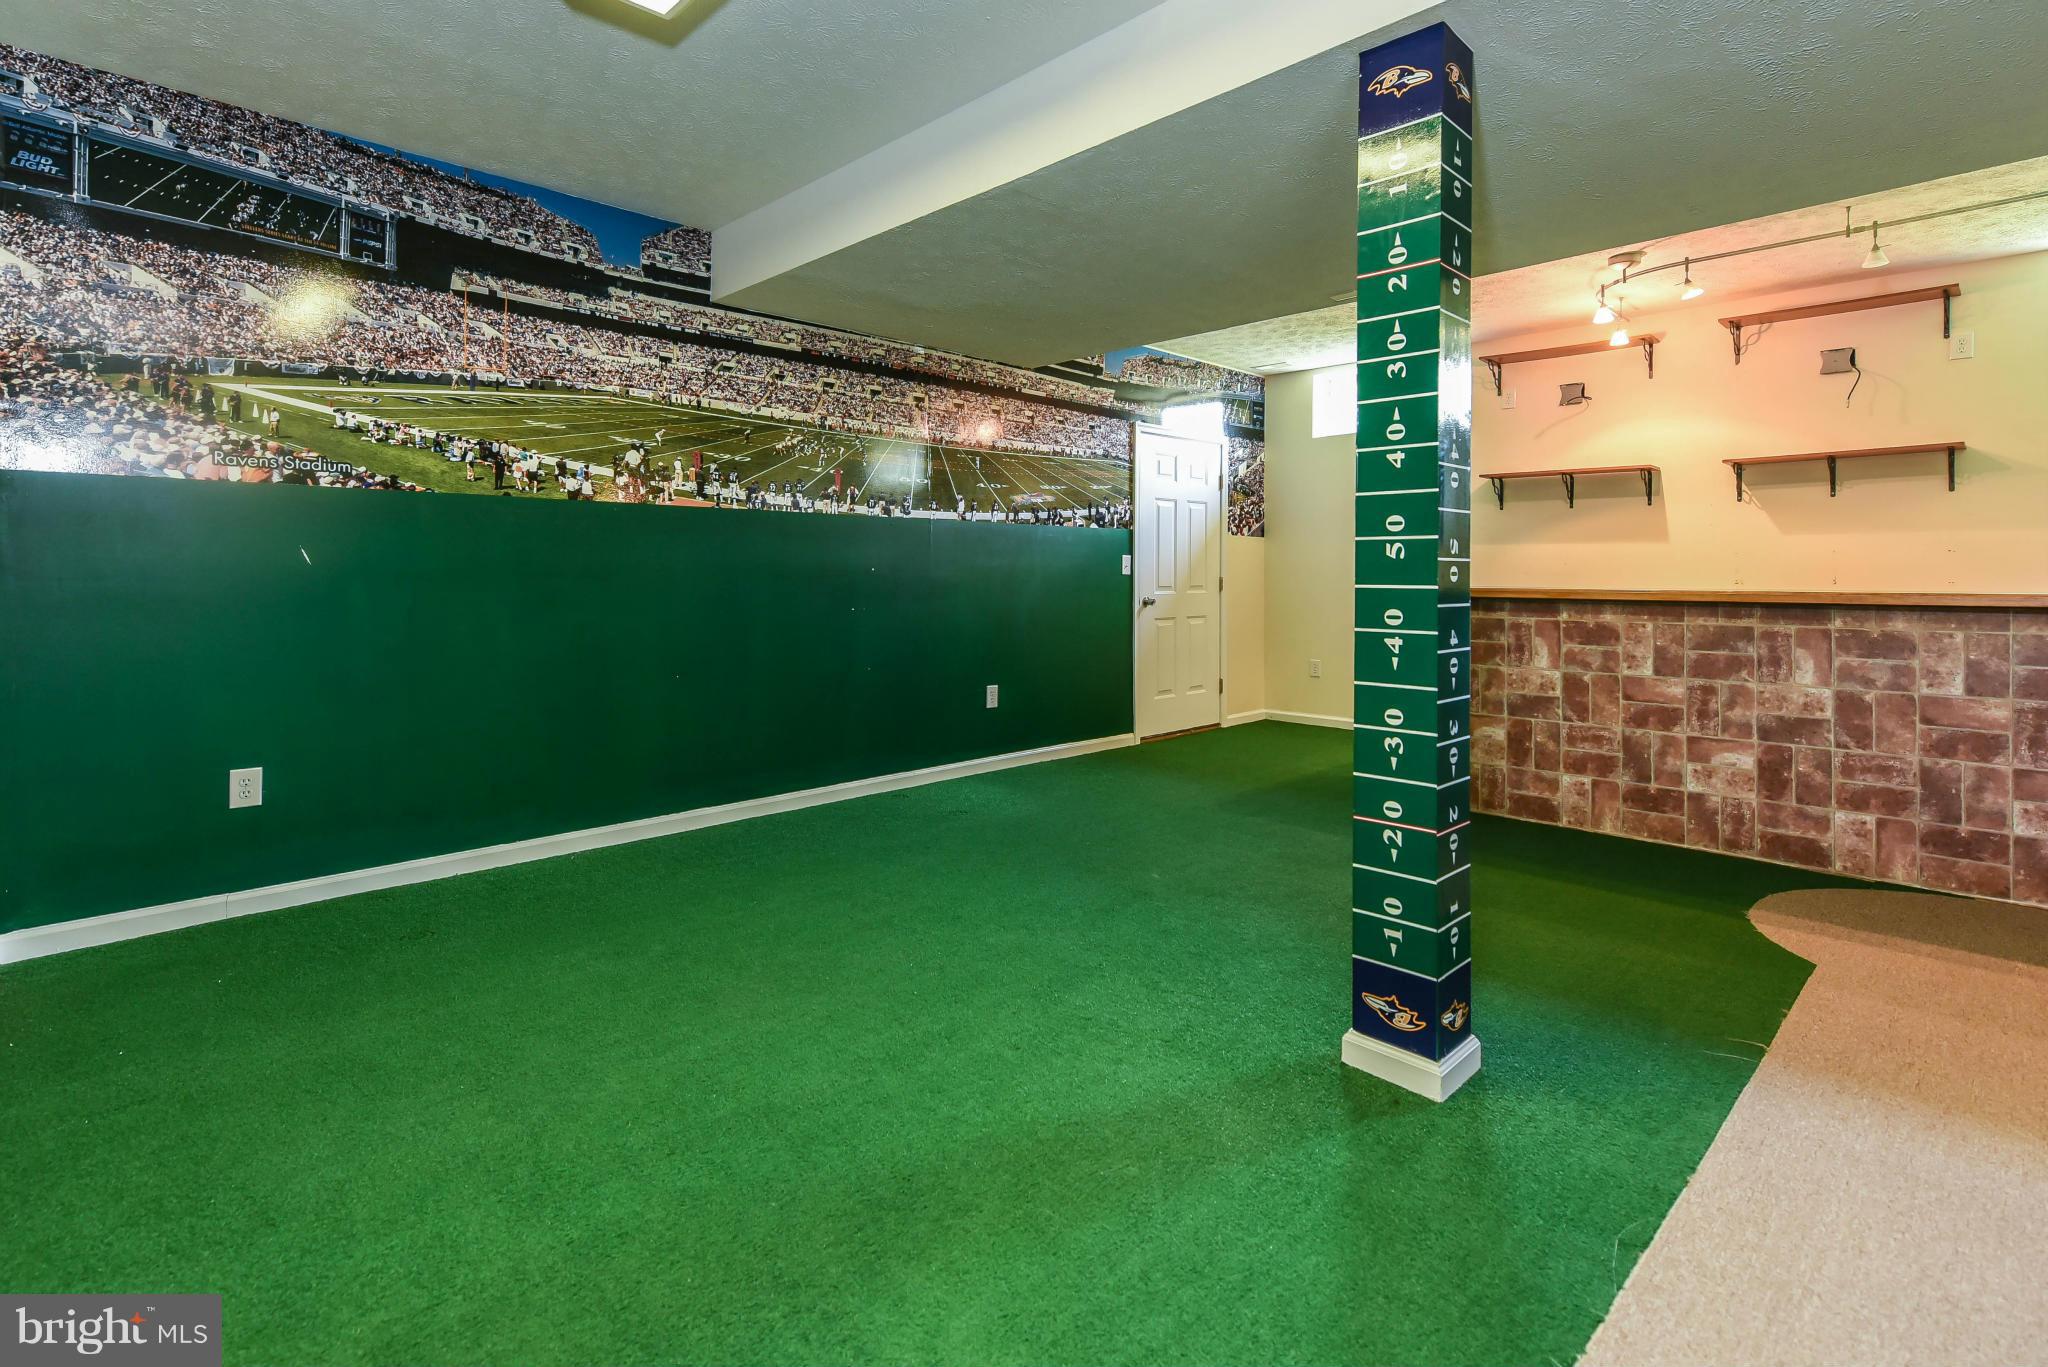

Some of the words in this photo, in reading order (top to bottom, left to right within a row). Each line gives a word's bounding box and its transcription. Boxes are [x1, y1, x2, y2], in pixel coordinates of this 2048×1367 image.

[10, 156, 60, 175] LIGHT
[17, 150, 53, 165] BUD
[1388, 246, 1408, 293] 20
[1387, 333, 1407, 379] 30
[214, 450, 278, 468] Ravens
[284, 455, 351, 473] Stadium
[1386, 423, 1406, 468] 40
[1386, 514, 1405, 559] 50
[1384, 608, 1403, 654] 40
[1384, 708, 1404, 755] 30
[1383, 800, 1403, 848] 20
[1383, 897, 1403, 944] 10
